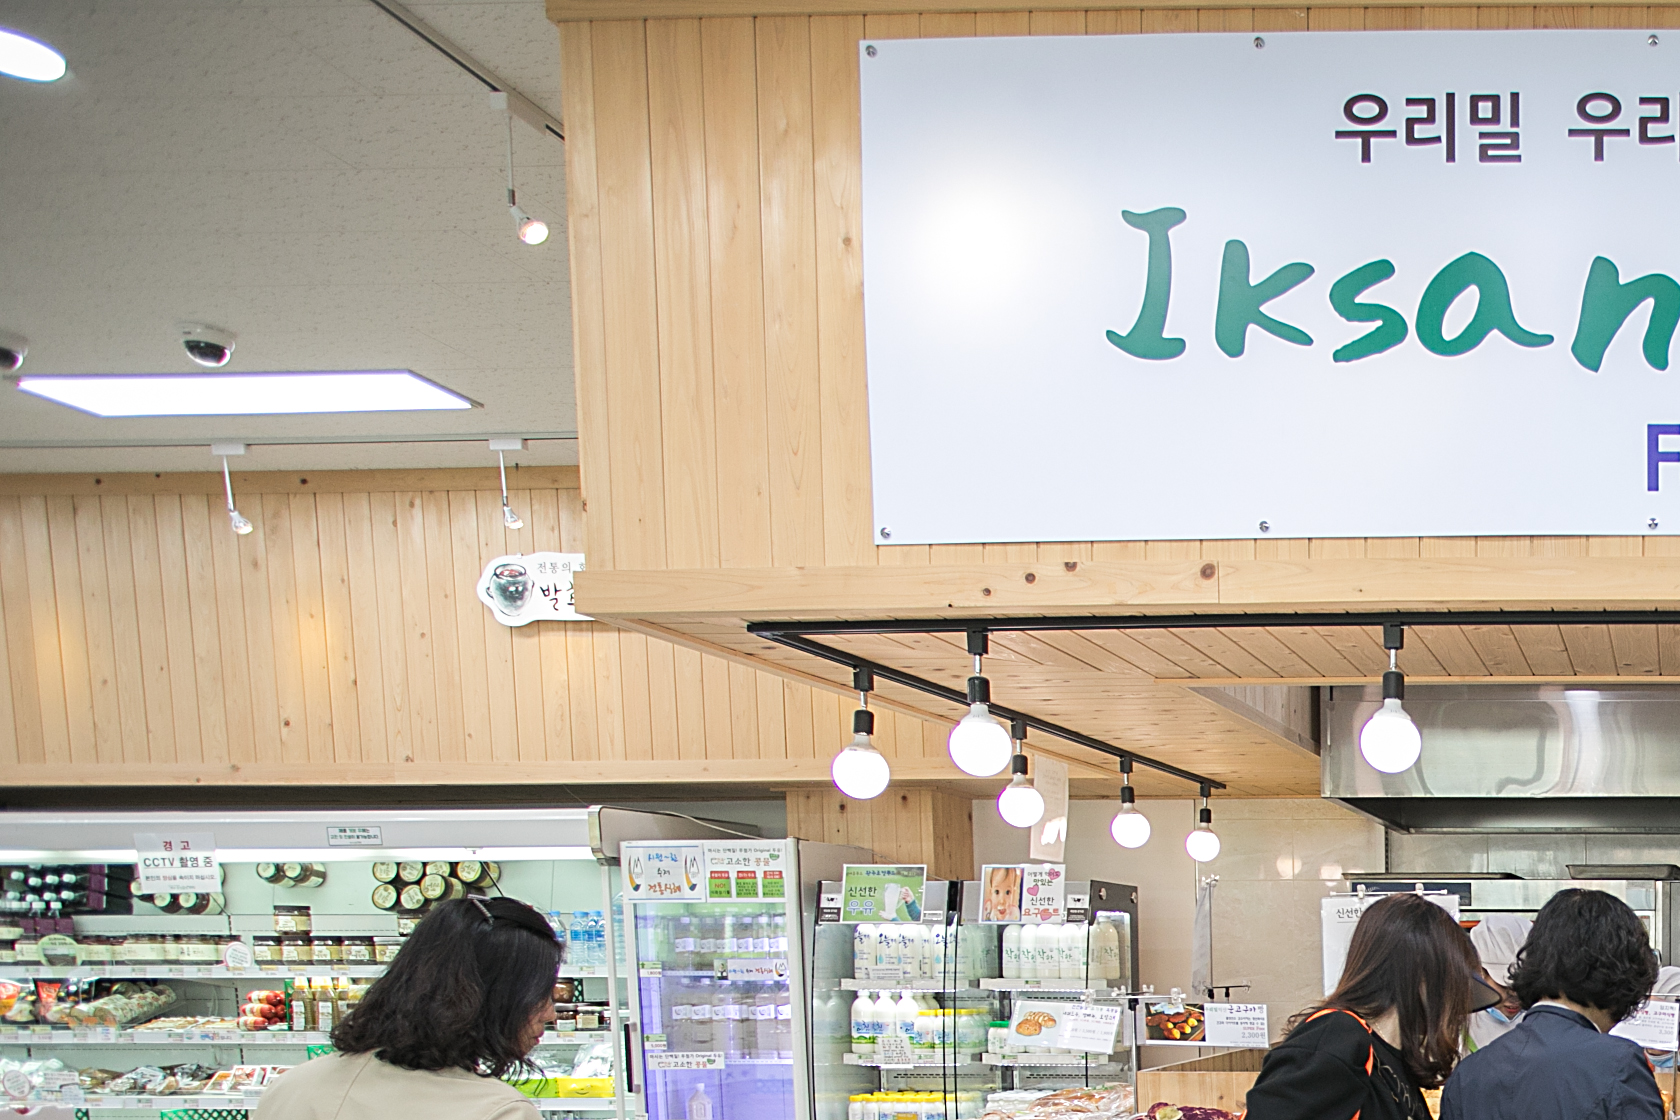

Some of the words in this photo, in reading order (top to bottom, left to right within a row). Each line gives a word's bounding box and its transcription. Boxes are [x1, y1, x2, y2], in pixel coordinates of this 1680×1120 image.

[1334, 92, 1524, 164] 우리밀
[537, 561, 572, 574] 전통의
[163, 840, 173, 852] 경
[181, 841, 191, 851] 고
[143, 857, 175, 867] CCTV
[179, 856, 199, 868] 촬영
[203, 856, 213, 868] 중
[726, 857, 751, 867] 고소한
[648, 883, 682, 896] 전통식혜
[848, 886, 878, 898] 신선한
[1030, 896, 1055, 906] 신선한
[847, 900, 876, 916] 우유
[1241, 1031, 1266, 1040] 2,300원
